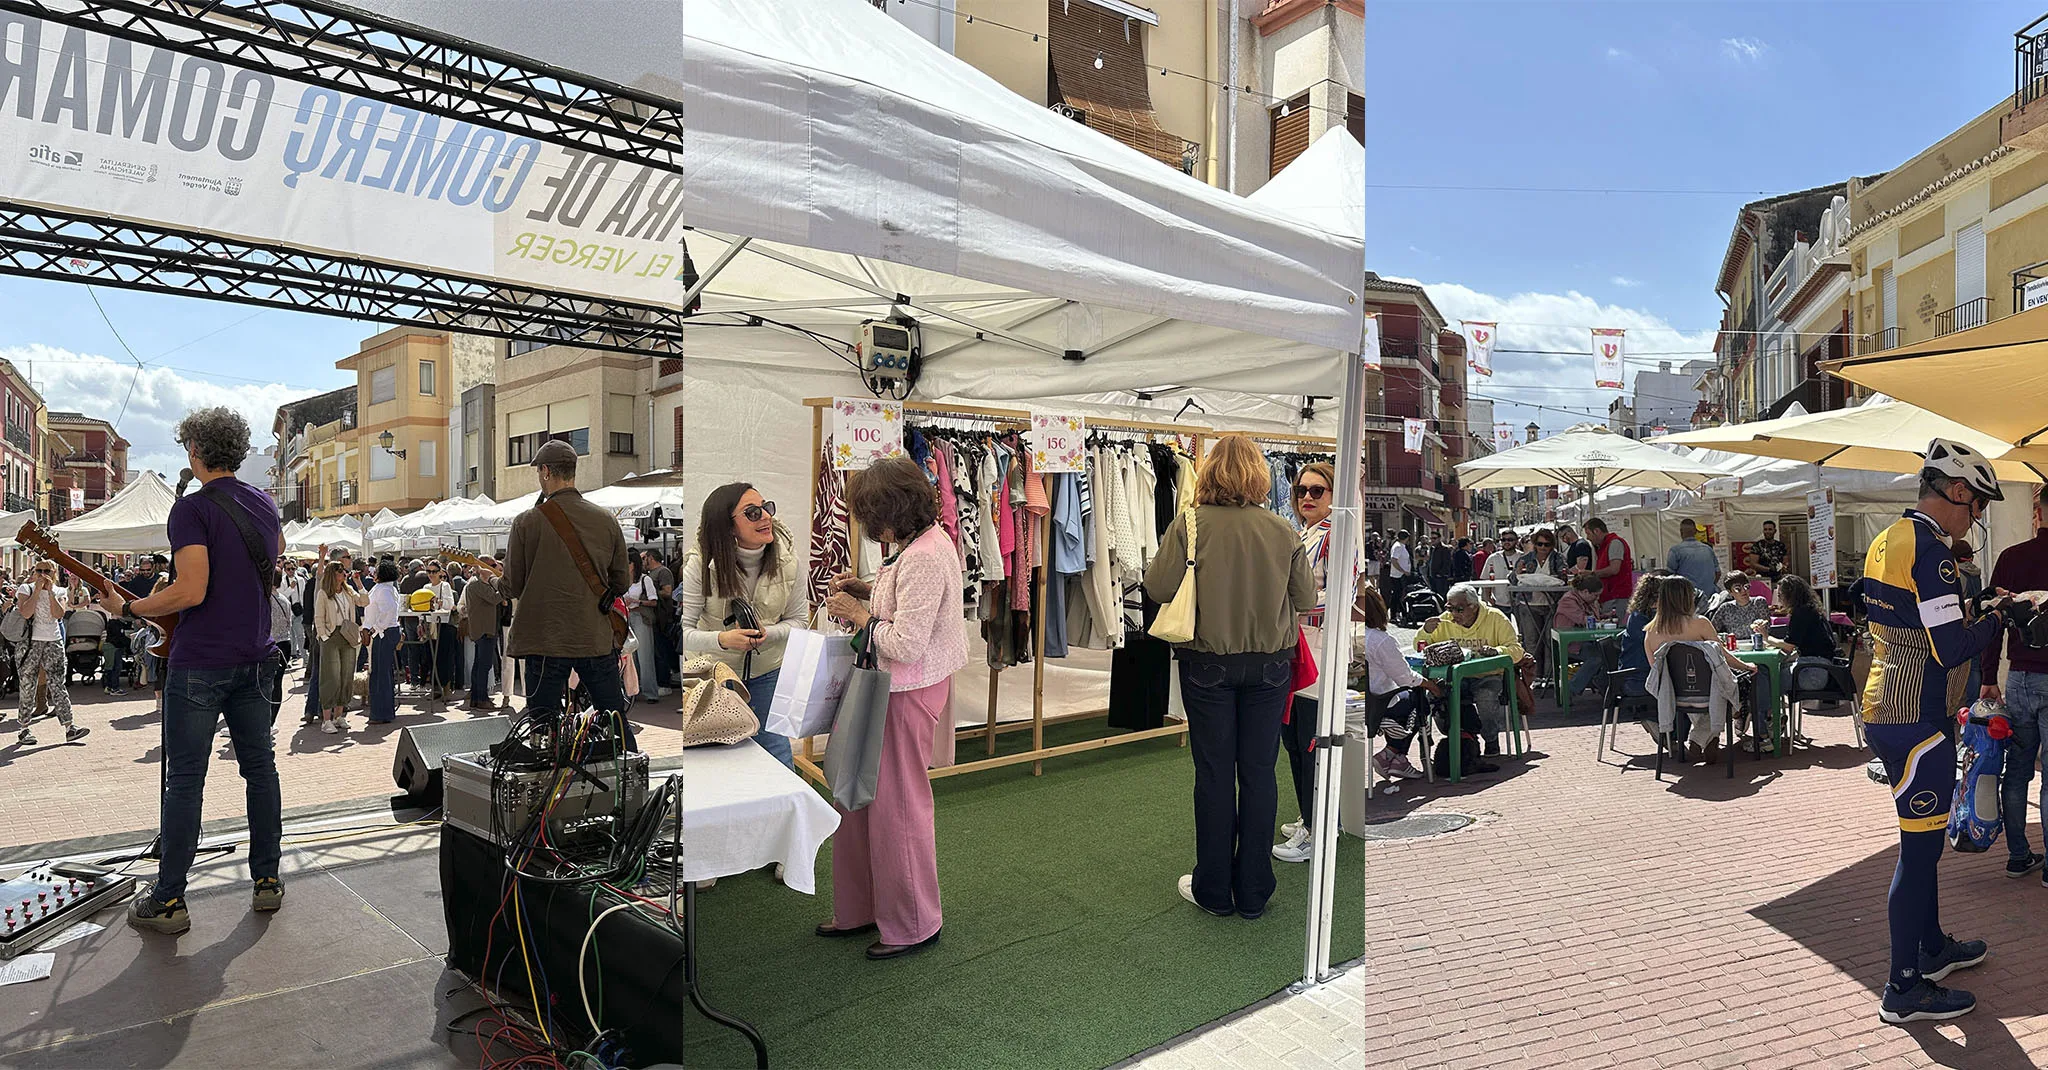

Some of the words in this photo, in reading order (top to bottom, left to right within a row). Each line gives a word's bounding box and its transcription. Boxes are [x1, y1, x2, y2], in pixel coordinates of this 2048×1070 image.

[2036, 293, 2048, 304] VEN
[854, 427, 881, 443] 10€
[1047, 437, 1067, 450] 15€
